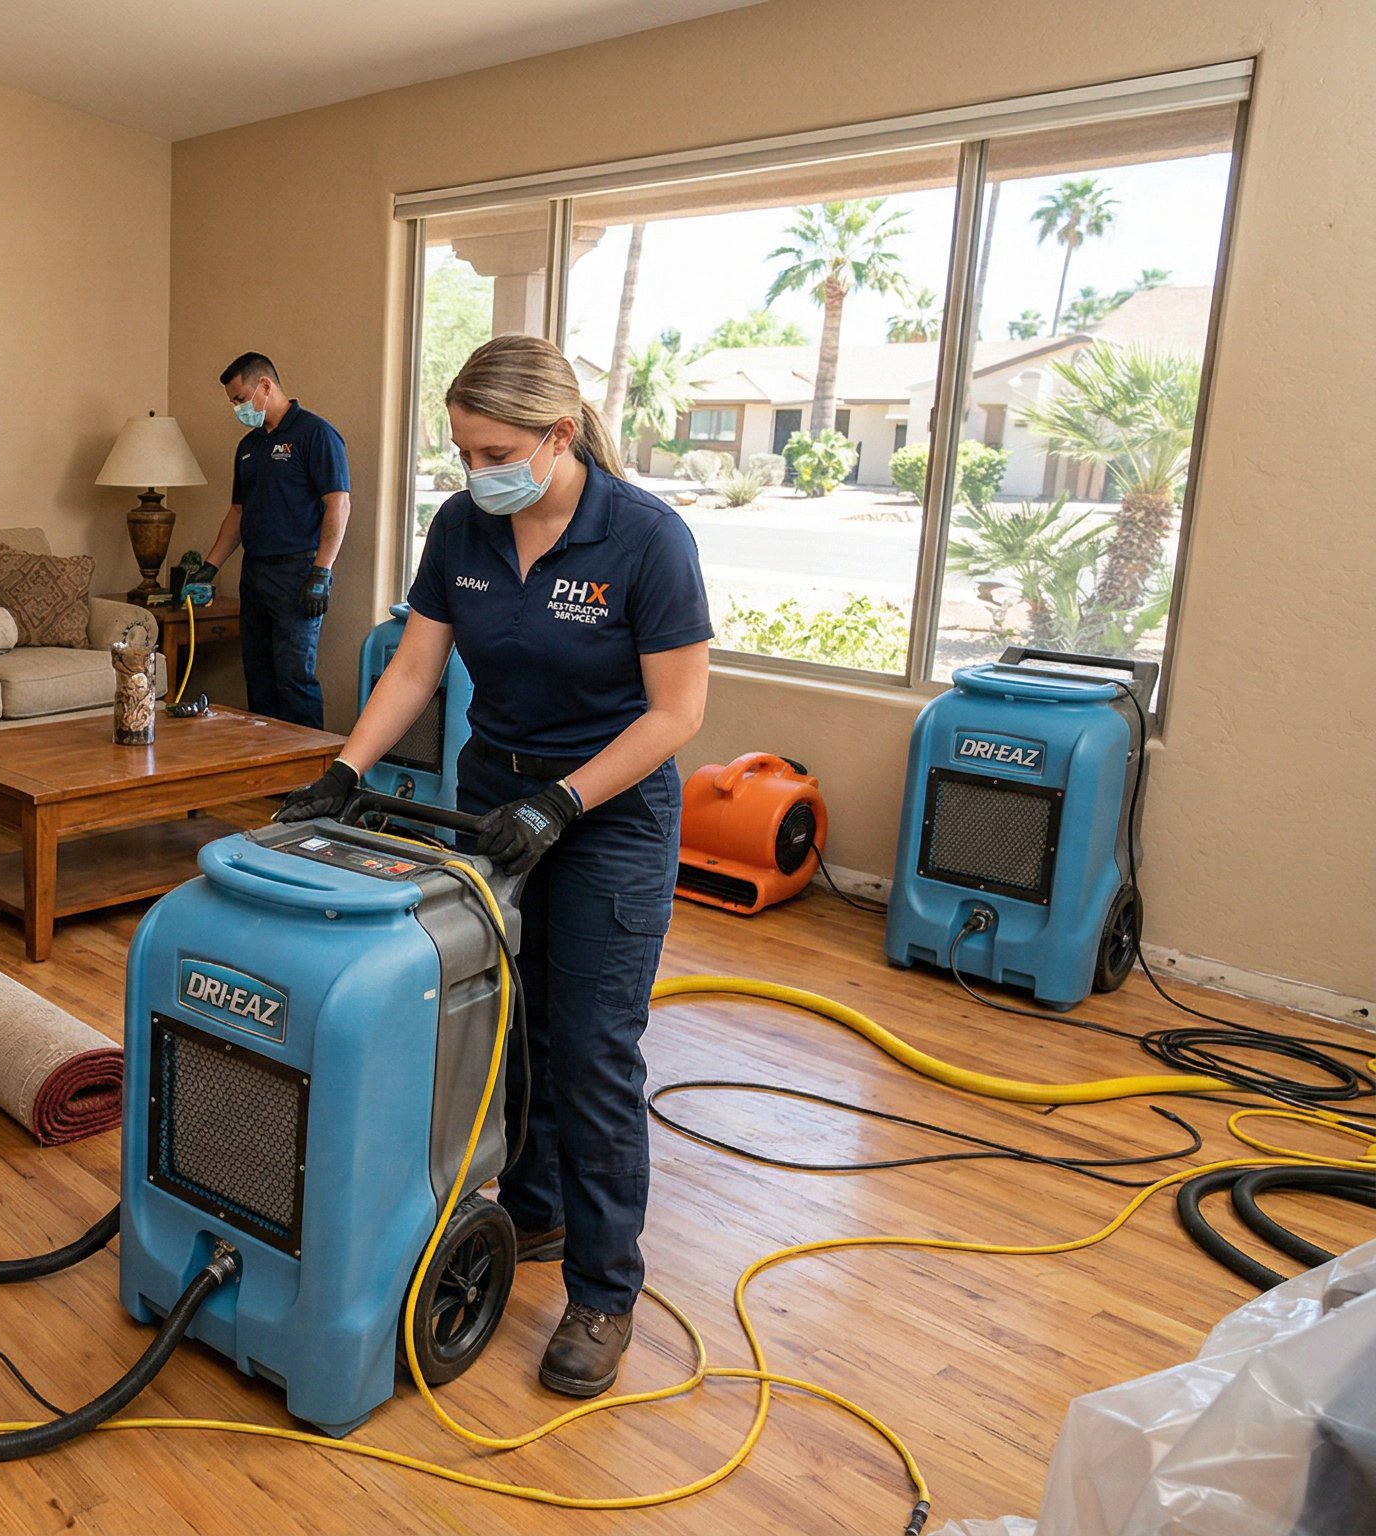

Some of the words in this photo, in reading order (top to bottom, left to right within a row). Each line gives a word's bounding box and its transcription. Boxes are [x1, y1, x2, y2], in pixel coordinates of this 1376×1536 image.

[456, 576, 490, 591] SARAH
[552, 579, 610, 605] PHX
[960, 739, 1040, 767] DRI-EAZ
[186, 973, 280, 1026] DRI-EAZ
